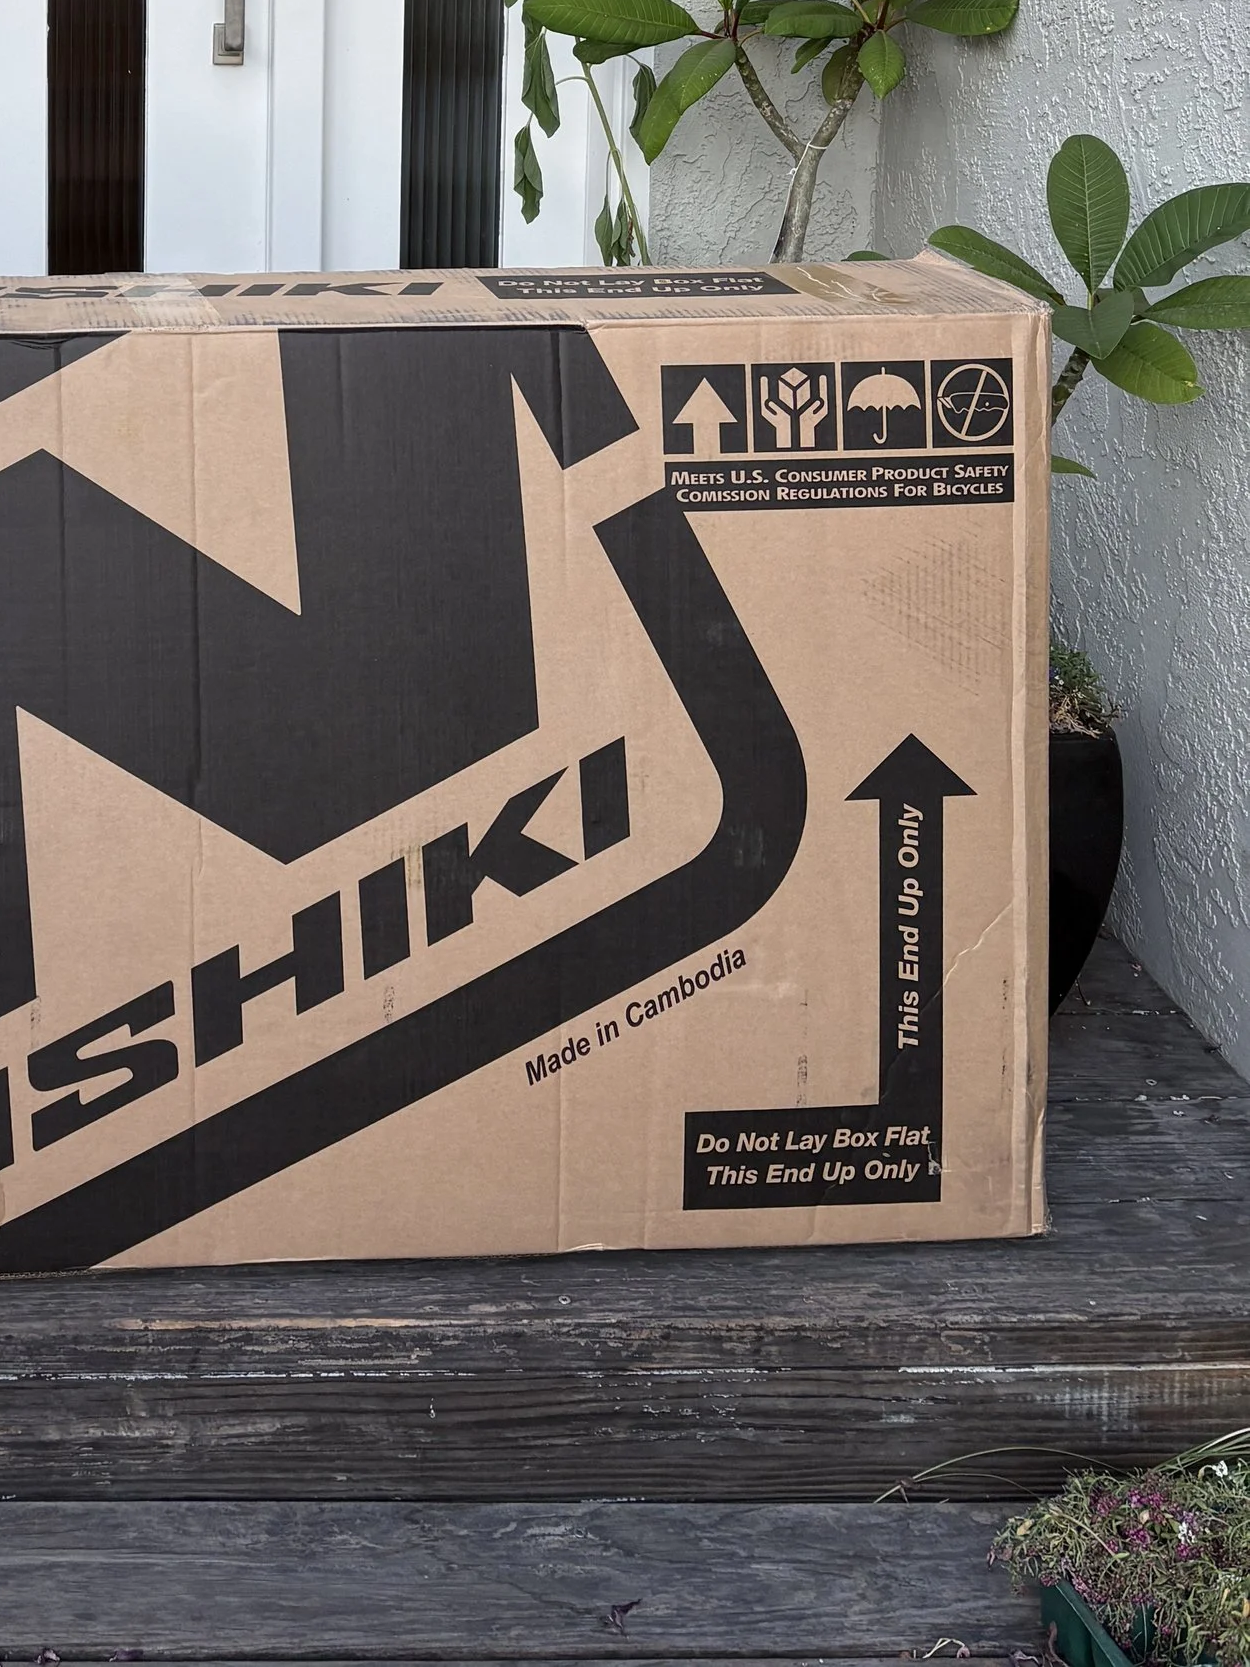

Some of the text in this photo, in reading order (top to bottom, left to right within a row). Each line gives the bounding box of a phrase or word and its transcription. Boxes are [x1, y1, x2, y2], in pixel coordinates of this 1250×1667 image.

[700, 284, 764, 292] Only
[730, 470, 769, 484] U.S.
[897, 803, 924, 1049] This End Up Only
[525, 948, 747, 1086] Made in Cambodia
[696, 1126, 931, 1153] Do Not Lay Box Flat
[706, 1159, 921, 1185] This End Up Only
